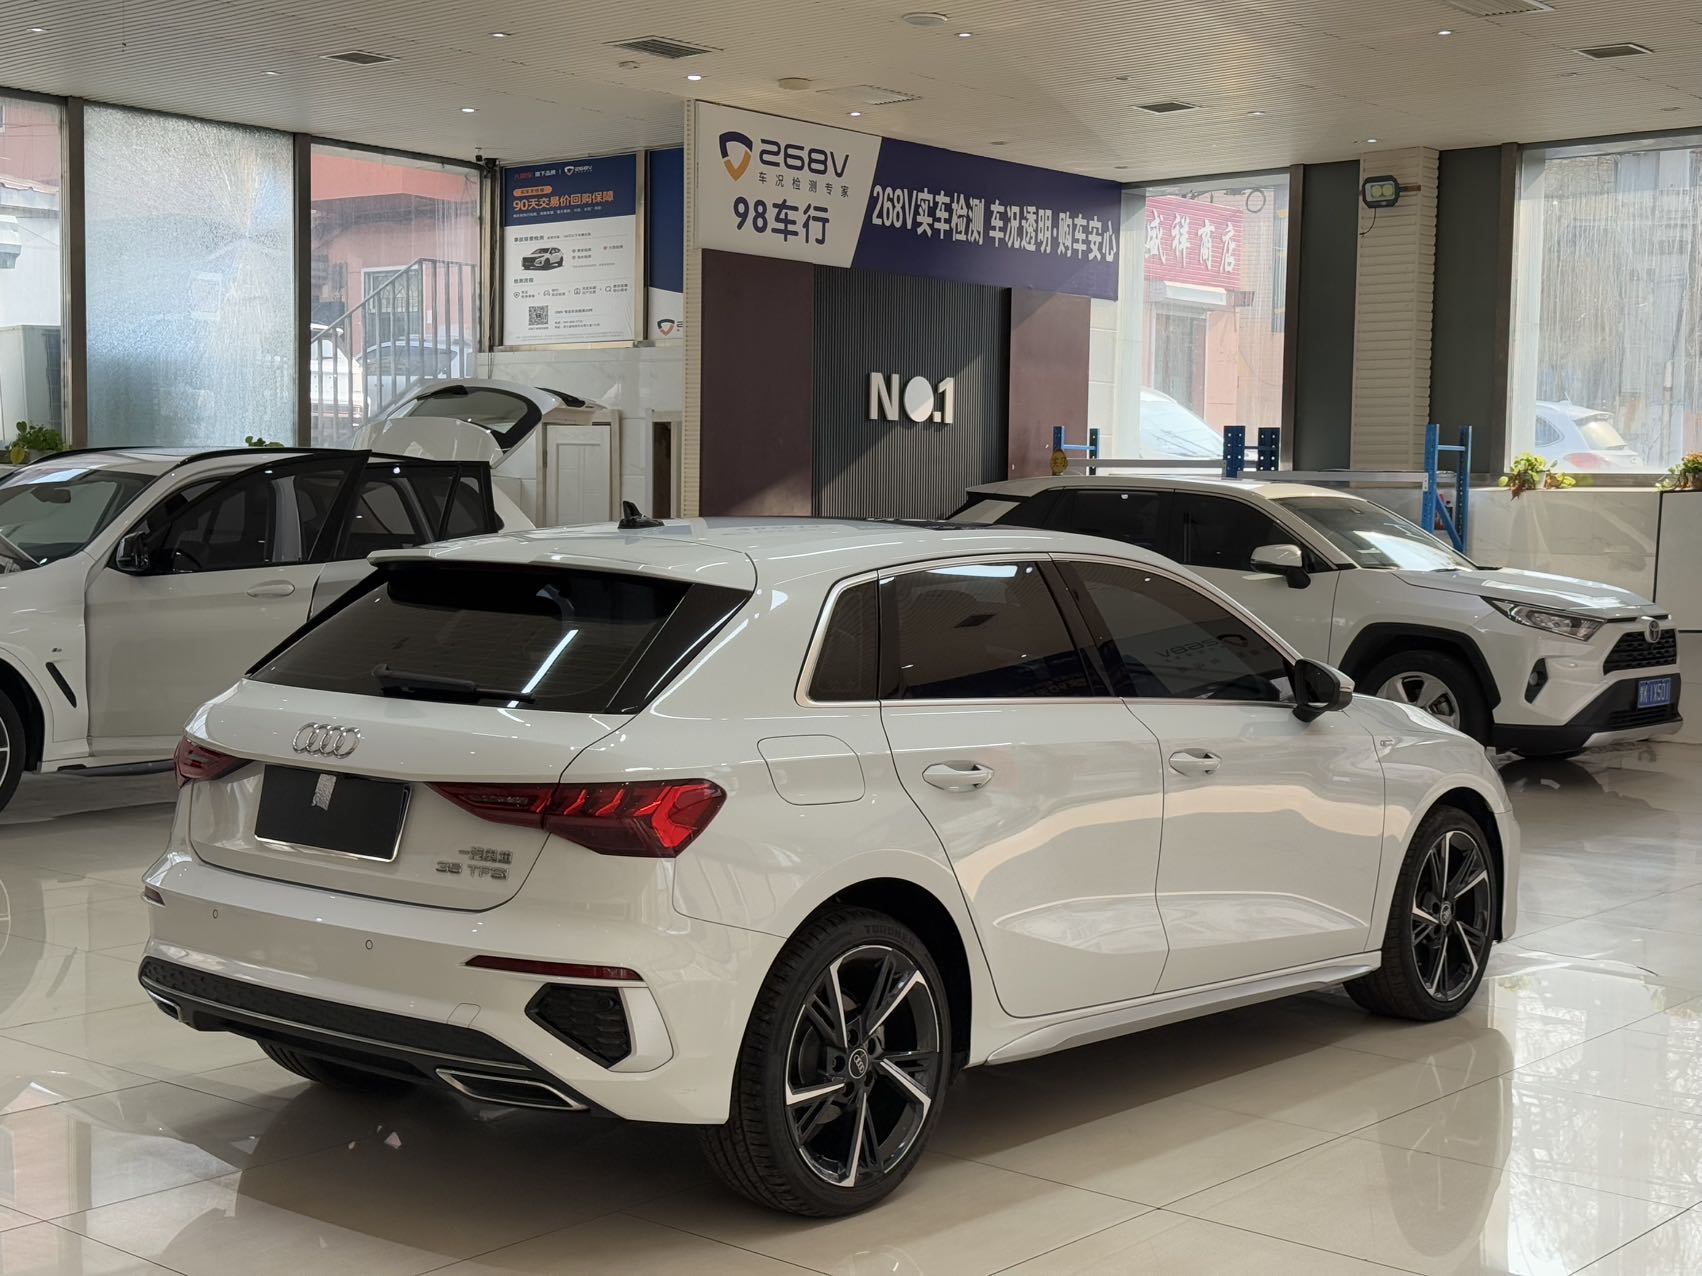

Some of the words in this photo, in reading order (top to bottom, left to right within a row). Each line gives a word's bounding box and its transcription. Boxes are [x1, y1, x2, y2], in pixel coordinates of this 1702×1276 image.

[758, 138, 850, 178] 268V
[513, 191, 614, 211] 90天交易价回购保障
[758, 171, 849, 198] 车况检测专家
[733, 196, 830, 245] 98车行
[872, 184, 985, 246] 268V实车检测
[1145, 208, 1235, 273] 盛祥商店
[868, 371, 955, 425] NO.1
[467, 864, 510, 880] TFSI
